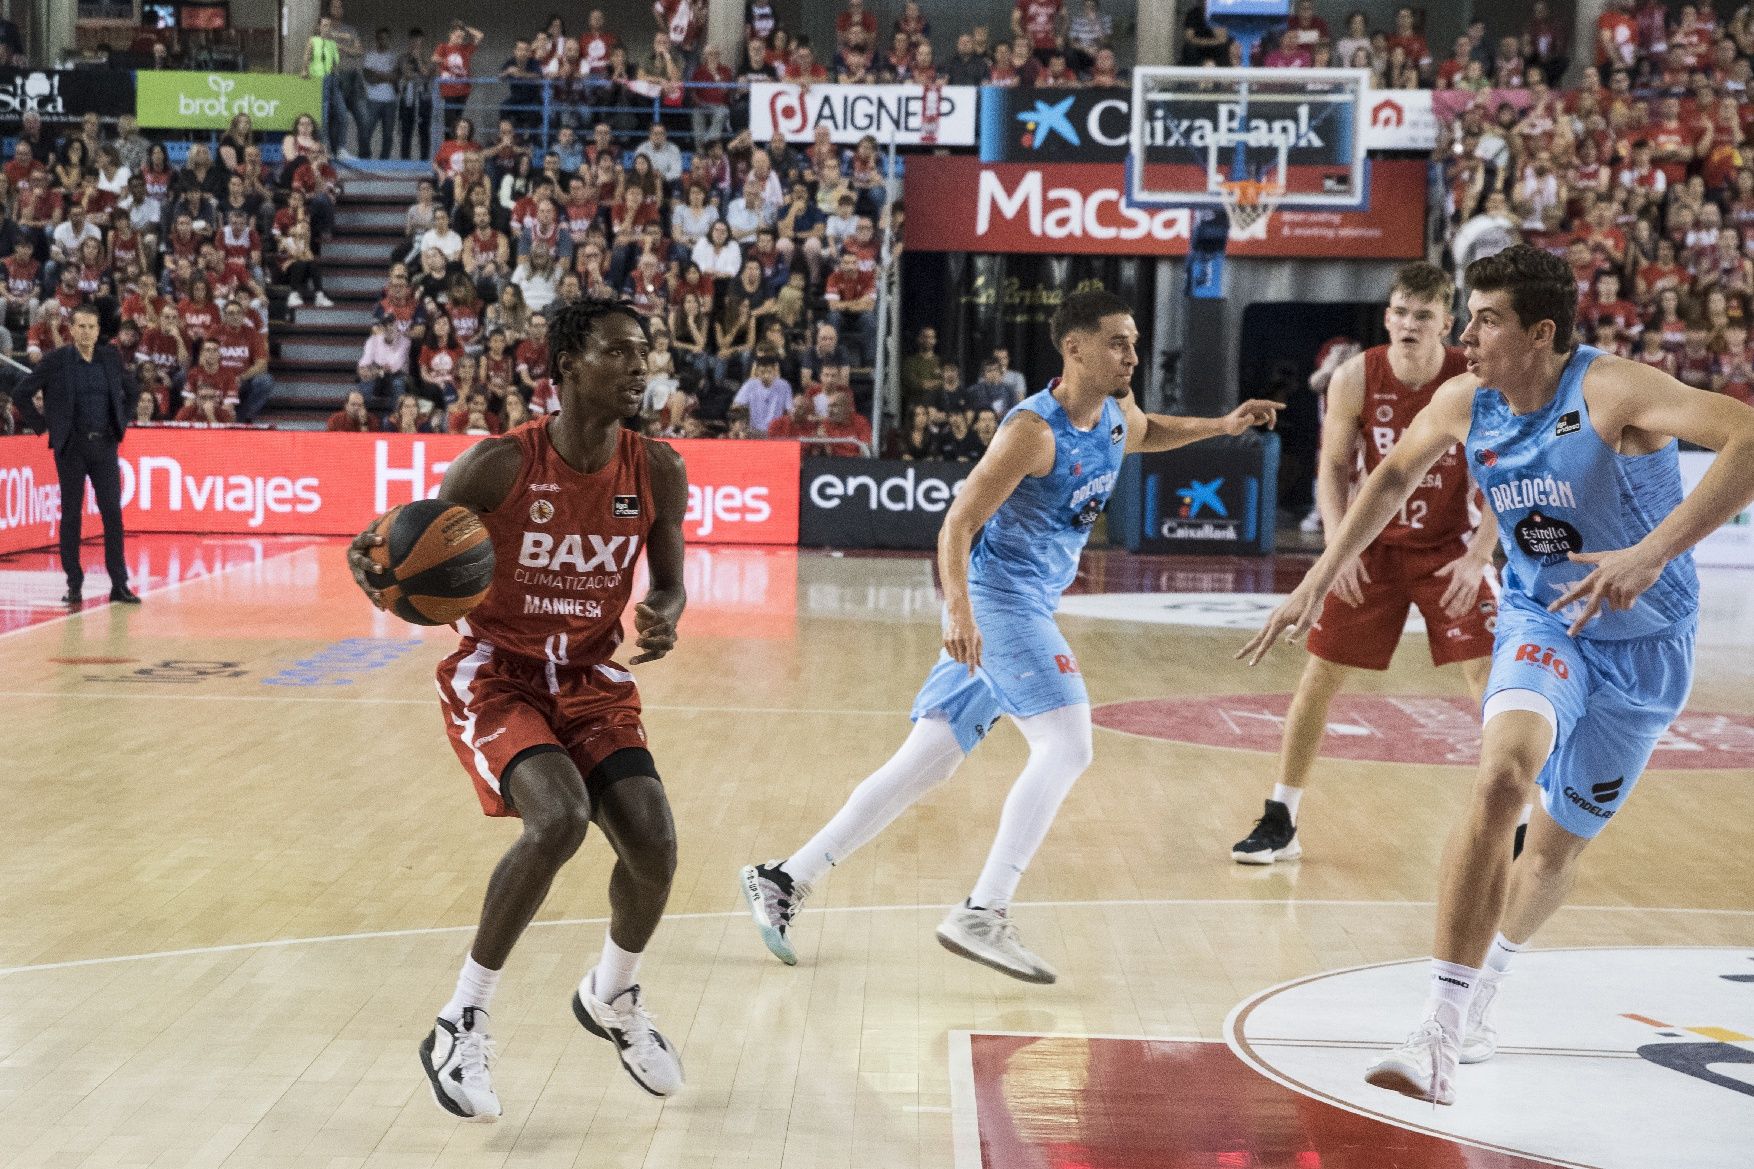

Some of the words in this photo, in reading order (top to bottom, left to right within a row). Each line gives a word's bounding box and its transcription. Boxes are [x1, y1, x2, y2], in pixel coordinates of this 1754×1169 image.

[179, 90, 229, 116] brot
[232, 94, 279, 117] d'or
[976, 169, 1190, 240] Macsa
[184, 474, 322, 527] viajes
[1398, 500, 1428, 529] 12
[1521, 526, 1568, 540] Estrella
[1529, 539, 1571, 554] Galicia
[518, 531, 640, 573] BAXI
